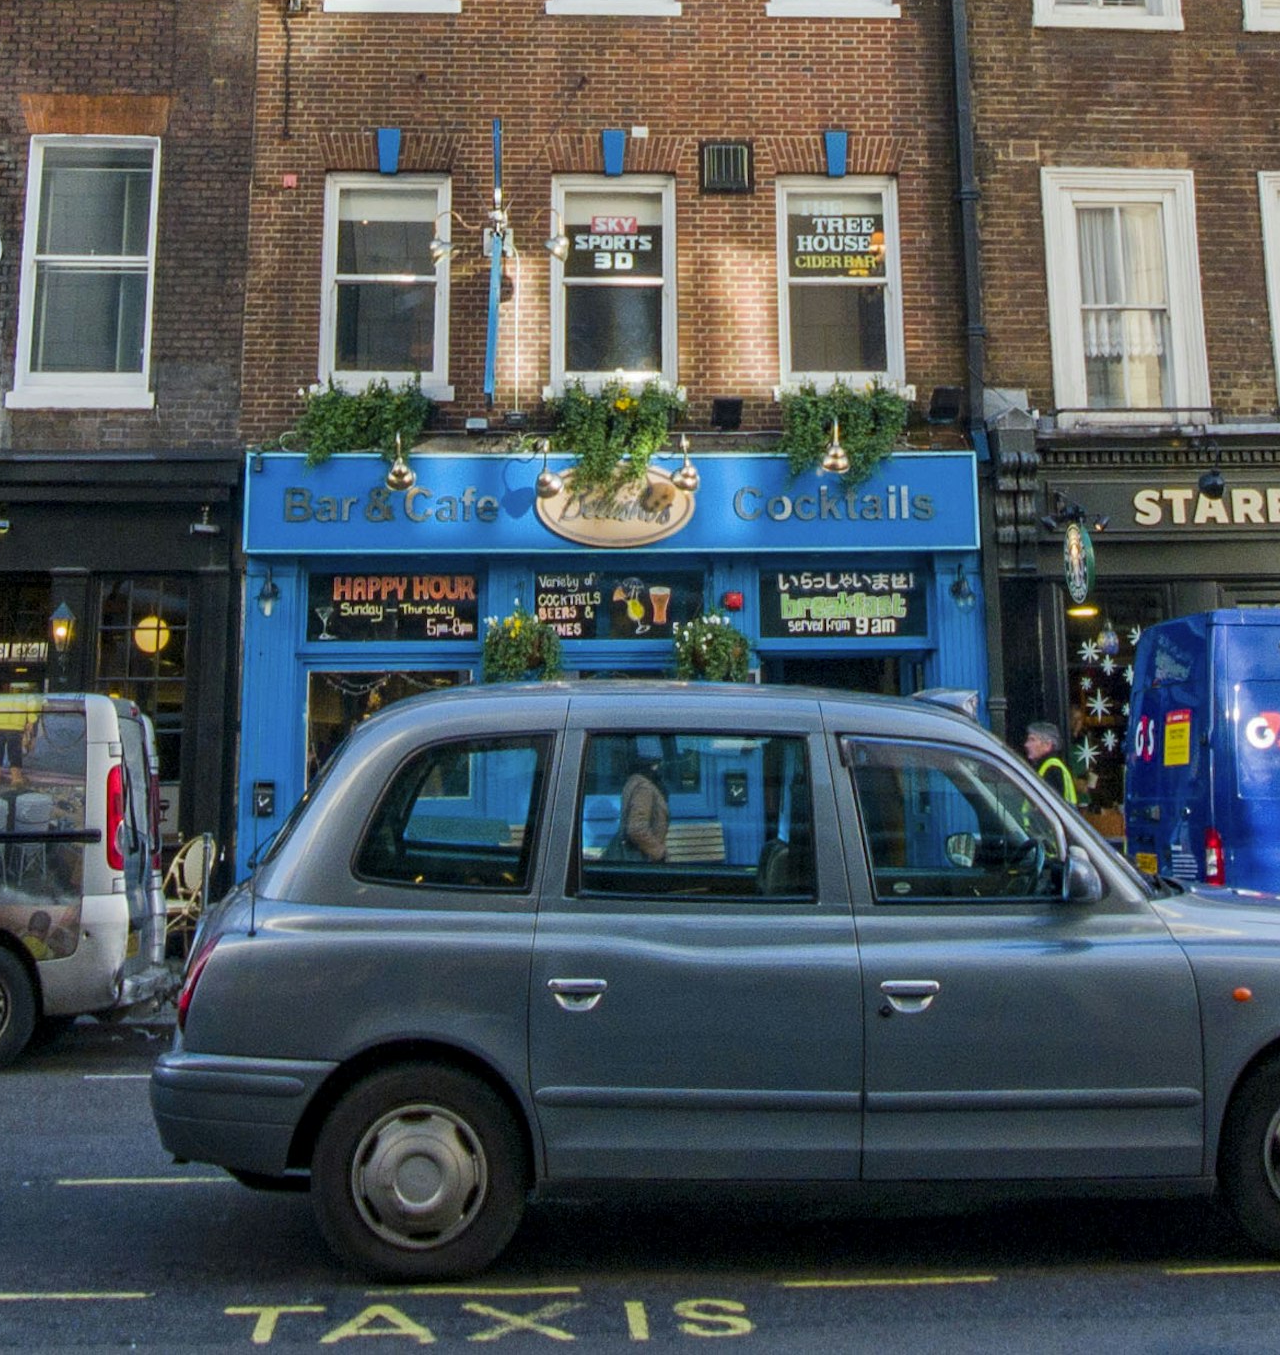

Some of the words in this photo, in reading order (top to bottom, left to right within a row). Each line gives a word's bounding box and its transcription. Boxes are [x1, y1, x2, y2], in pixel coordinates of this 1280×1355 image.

[594, 217, 633, 232] SKY
[811, 217, 874, 233] TREE
[574, 234, 652, 250] SPORTS
[796, 235, 871, 252] HOUSE
[594, 252, 633, 269] 3D
[795, 255, 842, 268] CIDER
[843, 255, 877, 268] BAR
[283, 487, 357, 523] Bar
[365, 487, 395, 522] &
[404, 486, 499, 523] Cafe
[733, 484, 935, 521] Cocktails
[333, 576, 408, 601] HAPPY
[413, 575, 476, 600] HOUR
[538, 574, 580, 593] Variety
[584, 572, 596, 586] of
[538, 591, 601, 607] COCKTAILS
[780, 591, 907, 619] breakfast
[340, 602, 383, 623] Sunday
[399, 602, 455, 620] Thursday
[538, 607, 577, 621] BEERS
[584, 606, 595, 620] &
[552, 622, 582, 637] INES
[787, 619, 824, 632] served
[826, 618, 851, 632] from
[855, 617, 869, 634] 9
[871, 619, 896, 634] am
[224, 1298, 757, 1345] TAXIS
